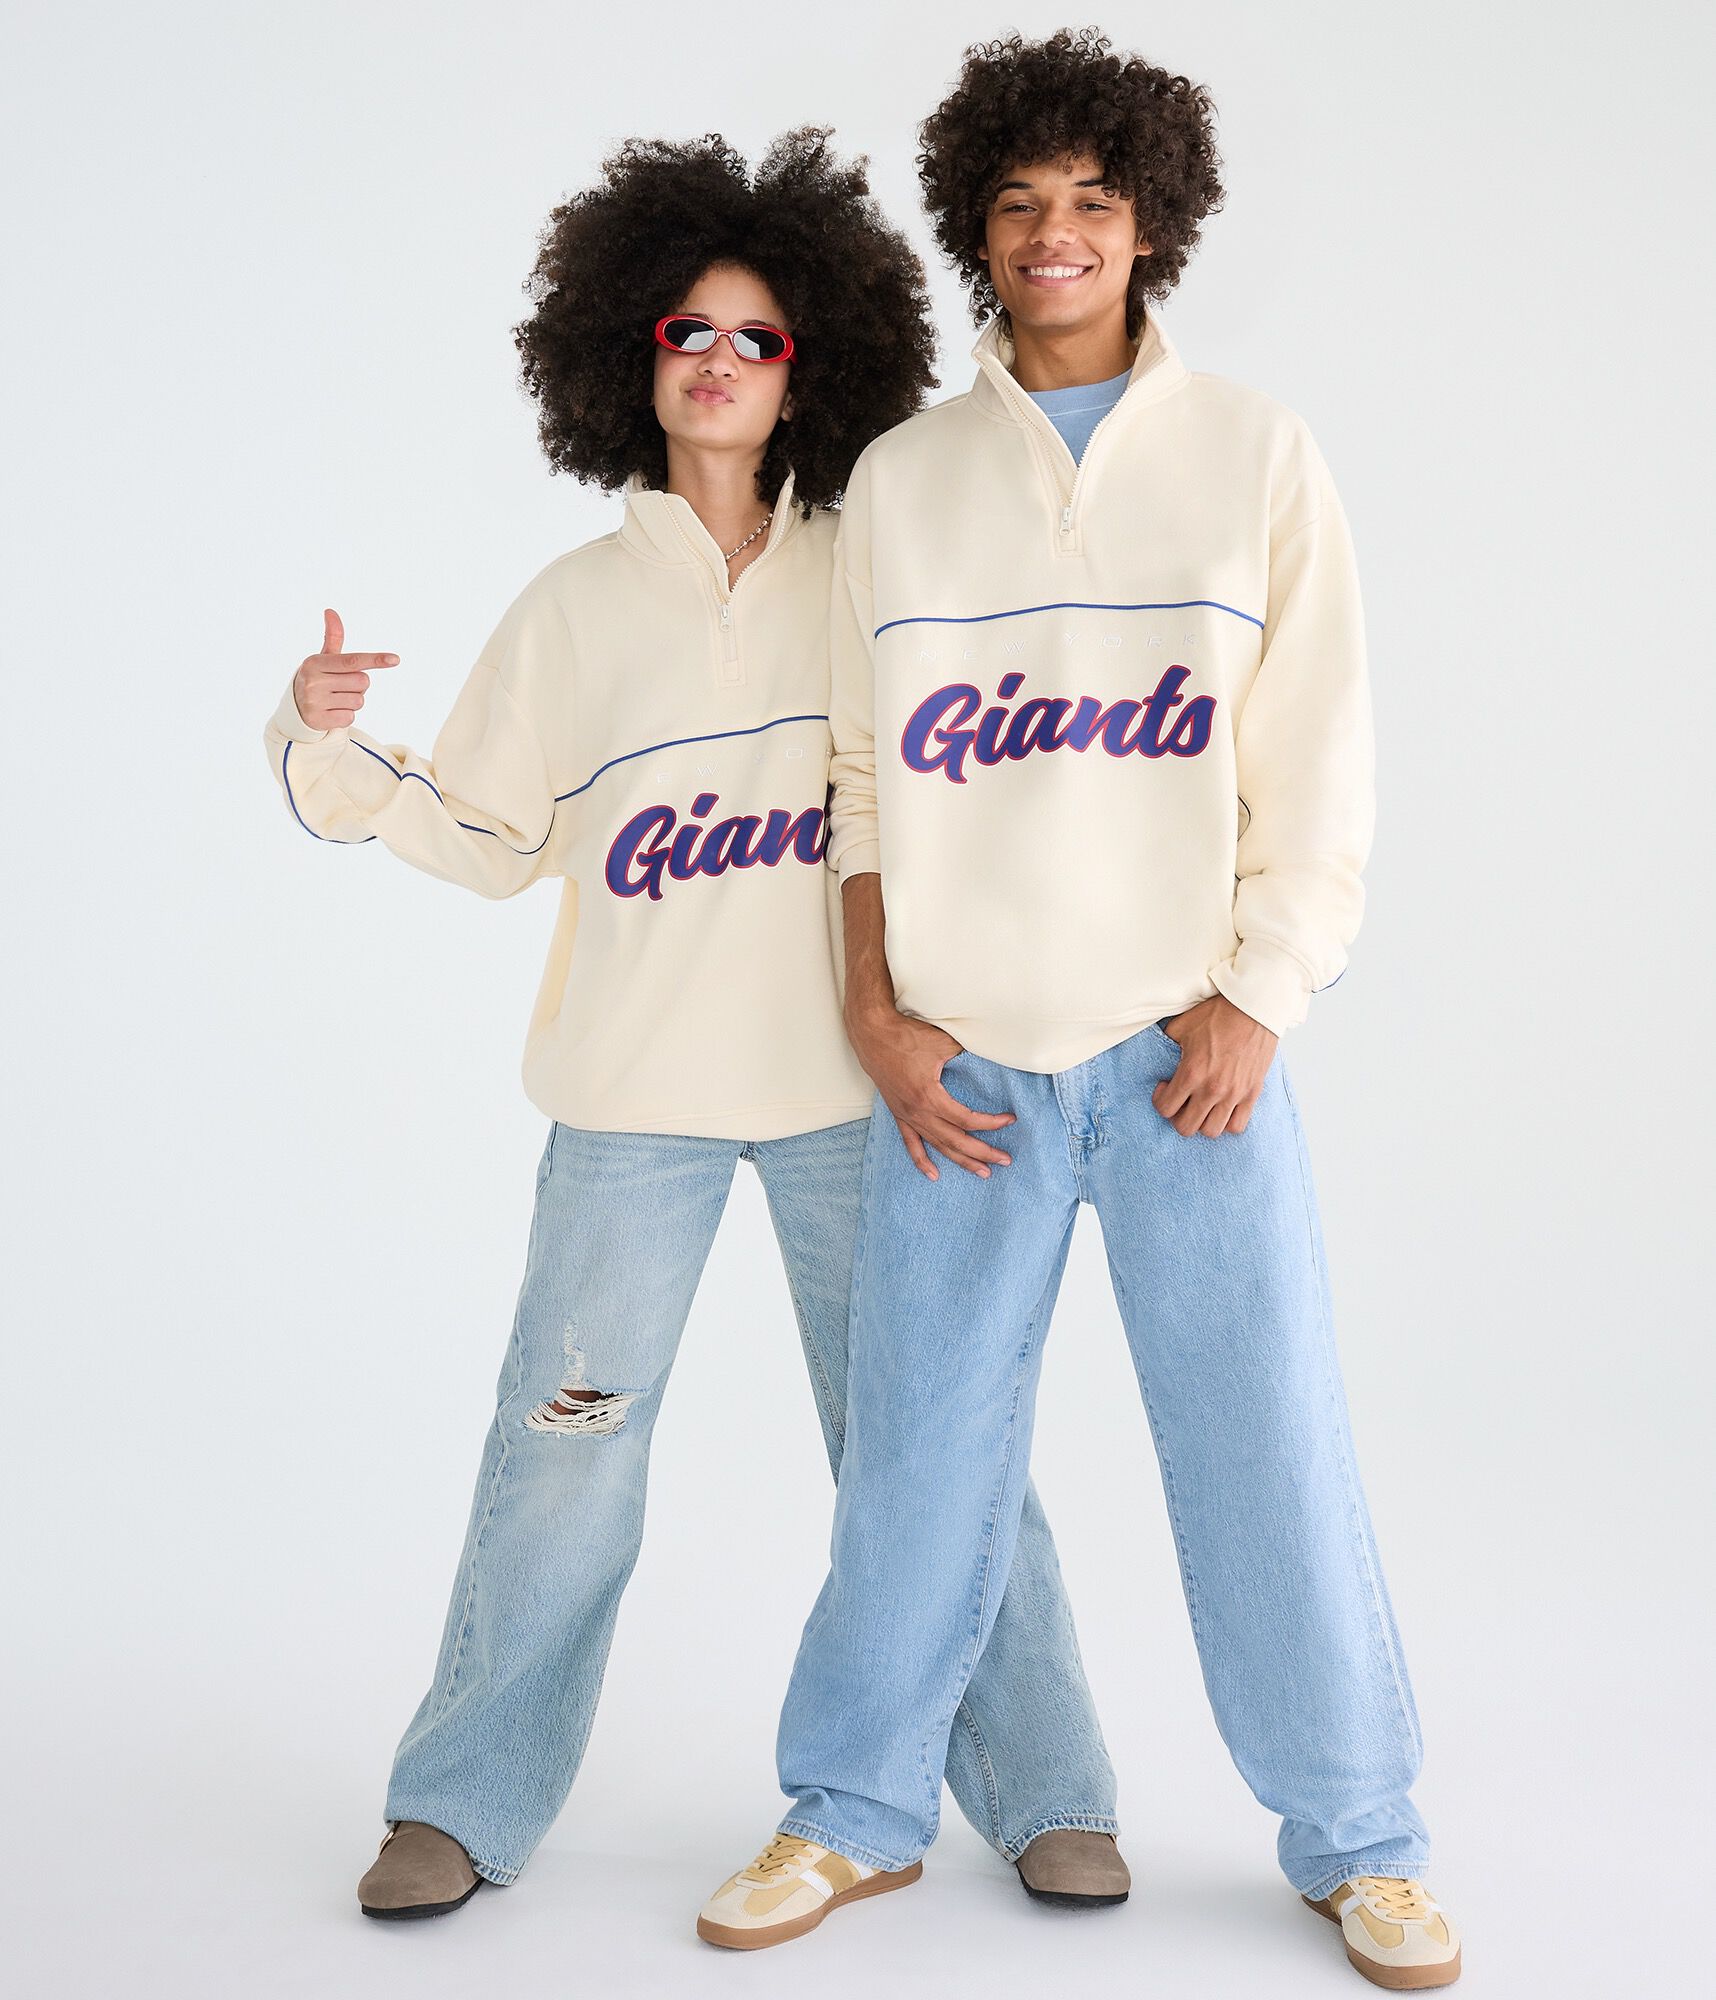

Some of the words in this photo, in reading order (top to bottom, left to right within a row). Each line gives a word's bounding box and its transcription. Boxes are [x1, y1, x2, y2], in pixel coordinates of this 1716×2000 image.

[919, 640, 1026, 661] NEW
[1063, 632, 1198, 649] YORK
[901, 664, 1217, 785] Giants
[605, 792, 828, 901] Gian
